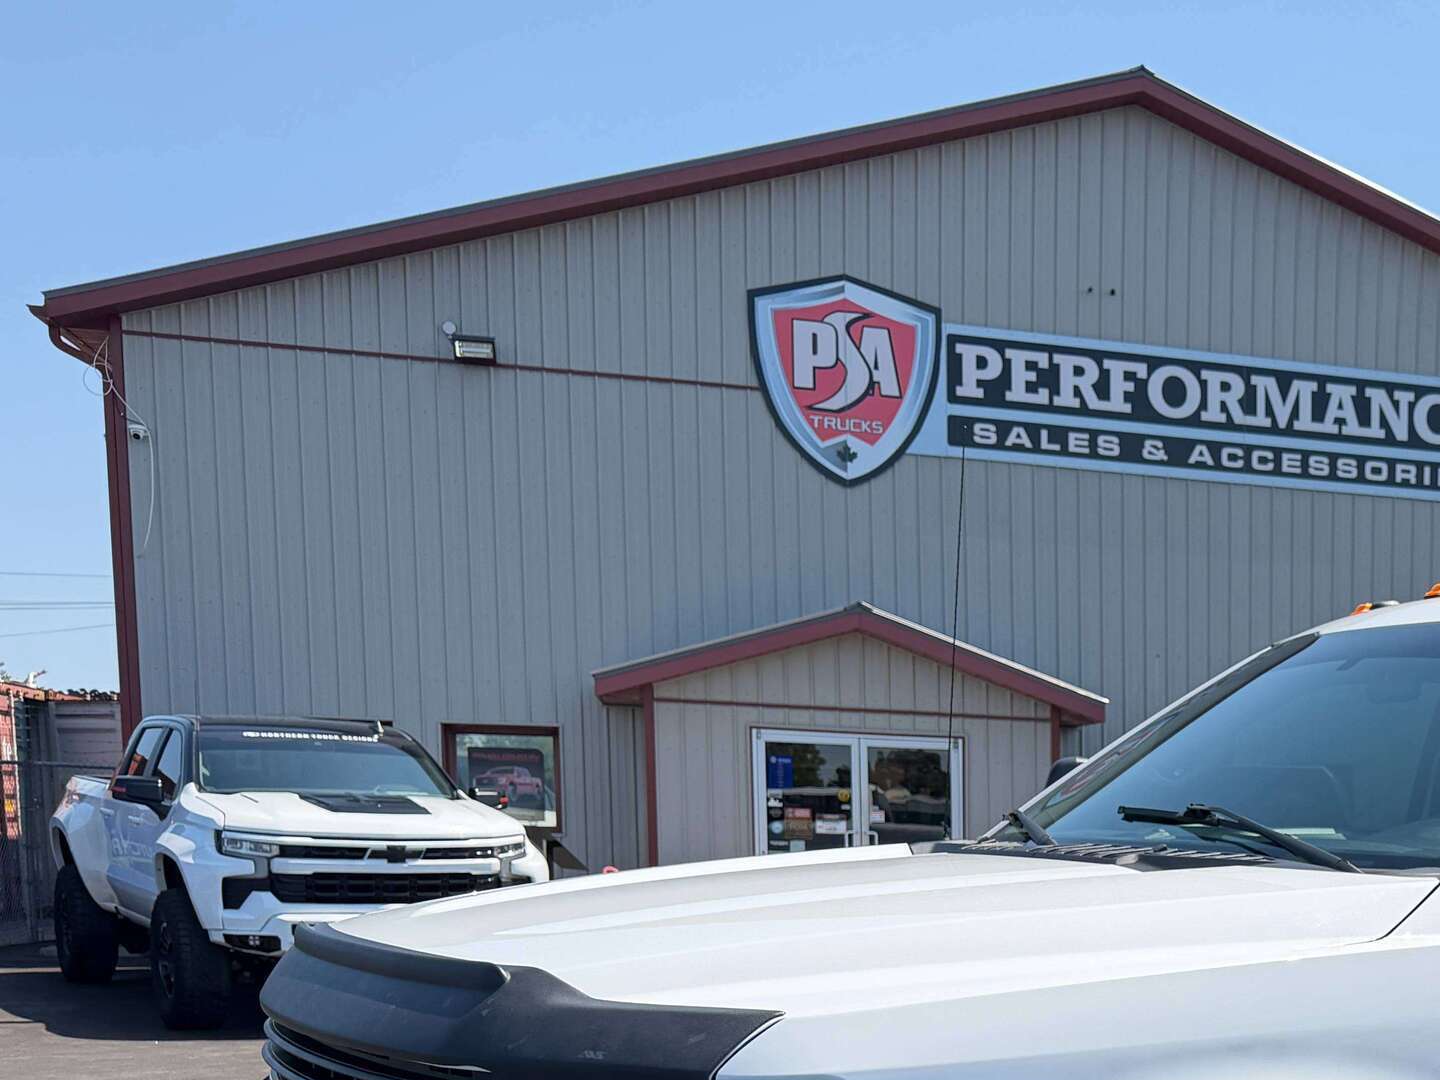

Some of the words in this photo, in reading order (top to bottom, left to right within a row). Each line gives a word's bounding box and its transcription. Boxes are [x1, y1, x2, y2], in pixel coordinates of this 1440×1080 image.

[792, 311, 903, 413] PSA
[810, 415, 884, 434] TRUCKS
[972, 422, 1121, 457] SALES
[1142, 439, 1168, 462] &
